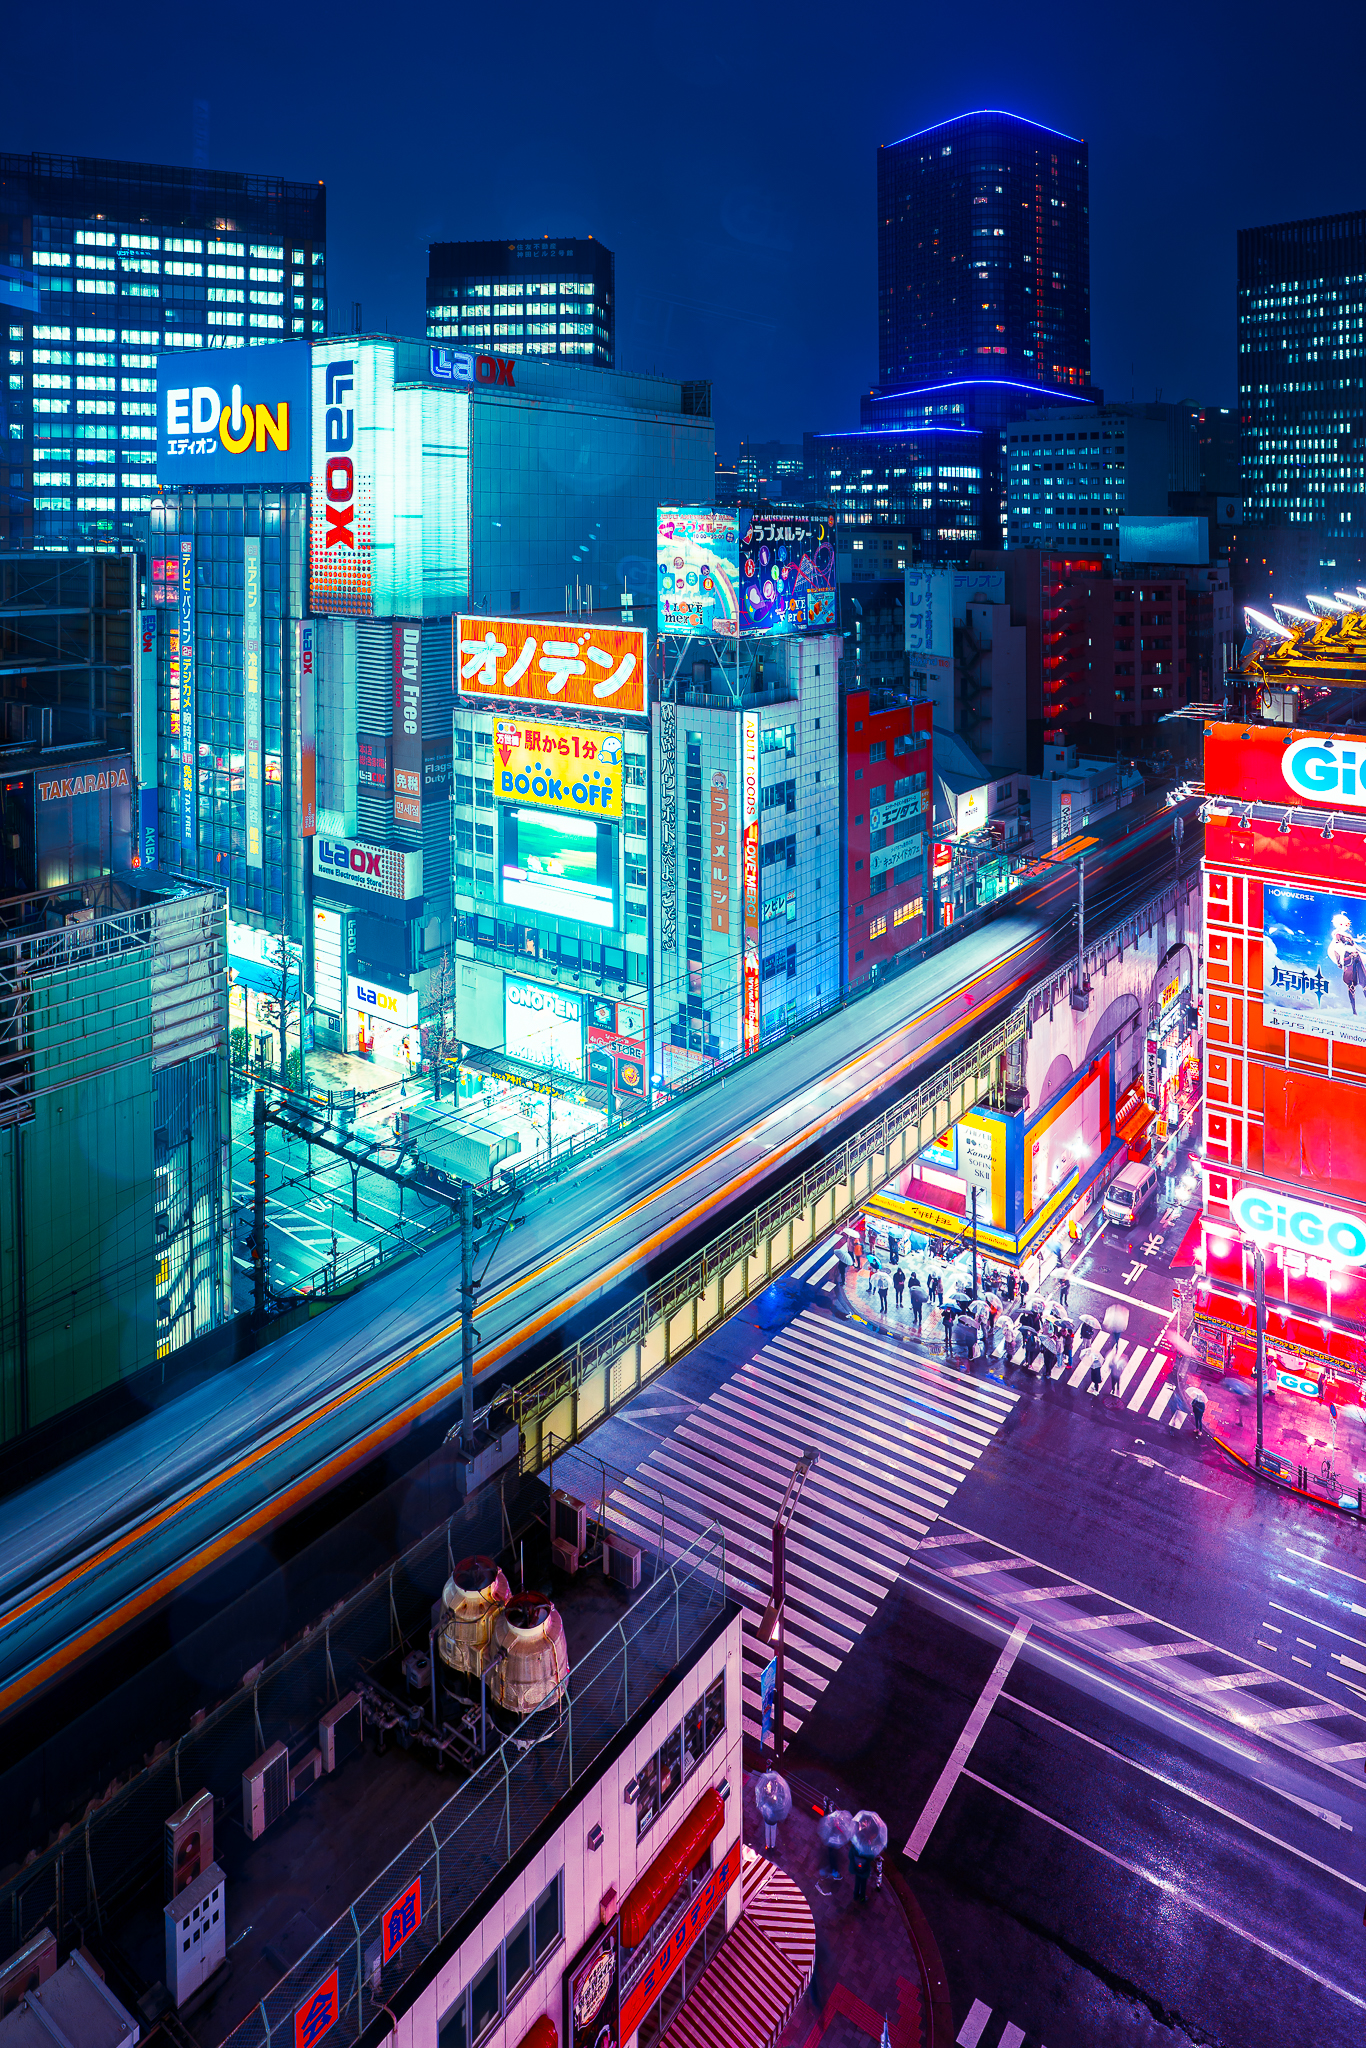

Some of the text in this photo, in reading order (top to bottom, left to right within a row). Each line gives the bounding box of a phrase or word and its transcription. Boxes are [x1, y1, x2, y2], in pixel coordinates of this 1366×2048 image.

[167, 384, 289, 454] EDION
[167, 438, 217, 455] エディオン
[676, 522, 734, 533] ラブメルシー
[753, 524, 812, 541] ラブメルシー
[954, 575, 1003, 588] テレオン
[910, 571, 923, 649] テレオン
[182, 646, 192, 656] 2F
[460, 631, 637, 699] オノデン
[402, 628, 420, 735] Duty Free
[248, 740, 259, 750] 4F
[525, 730, 598, 760] 駅から1分
[184, 765, 193, 791] 免税
[396, 773, 419, 792] 免税
[425, 774, 446, 785] Duty
[746, 720, 756, 815] ADULT GOODS
[39, 768, 130, 801] TAKARADA
[882, 800, 919, 826] エンタス
[145, 826, 156, 865] AKIBA
[712, 796, 728, 927] ラブメルシー
[318, 864, 382, 889] Home Electronics Store
[746, 837, 757, 919] LOVE MERCI
[1270, 964, 1330, 1008] 原神
[508, 986, 580, 1022] ONODEN
[611, 1041, 643, 1059] STORE
[966, 1147, 998, 1163] Kanebo
[1240, 1198, 1366, 1257] GiGO
[388, 1892, 416, 1952] 館
[644, 1861, 729, 1997] ミツワデンキ
[301, 1990, 335, 2048] 会
